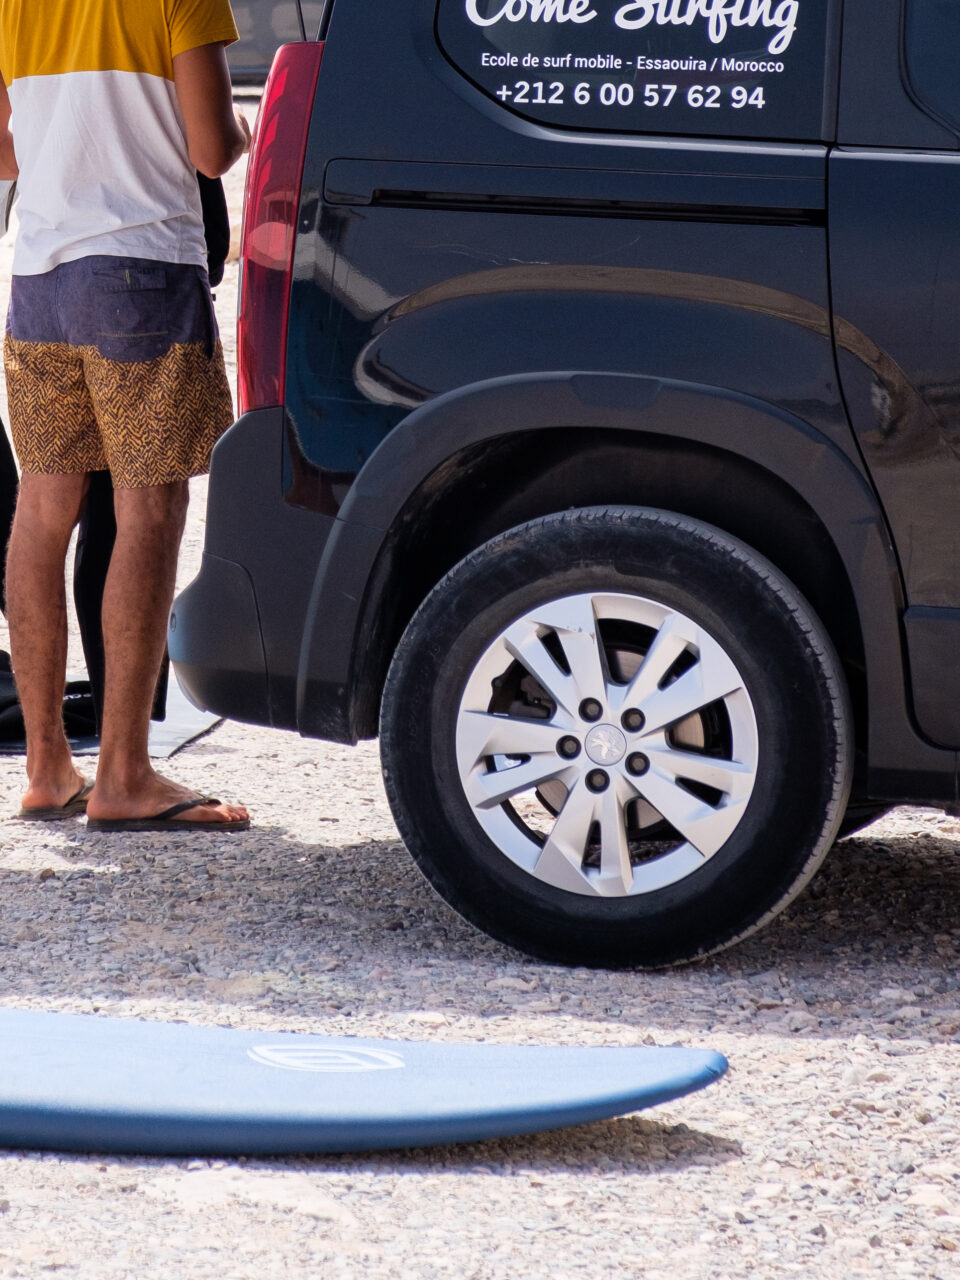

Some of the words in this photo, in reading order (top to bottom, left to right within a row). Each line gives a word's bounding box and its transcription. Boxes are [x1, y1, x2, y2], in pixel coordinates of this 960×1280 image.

[481, 52, 519, 68] Ecole
[522, 53, 540, 68] de
[543, 53, 573, 68] surf
[574, 54, 623, 70] mobile
[636, 55, 707, 71] Essaouira
[709, 57, 718, 72] /
[721, 57, 785, 73] Morocco
[495, 80, 565, 105] +212
[573, 81, 591, 106] 6
[599, 82, 634, 107] 00
[643, 83, 678, 107] 57
[686, 84, 722, 108] 62
[730, 85, 766, 109] 94
